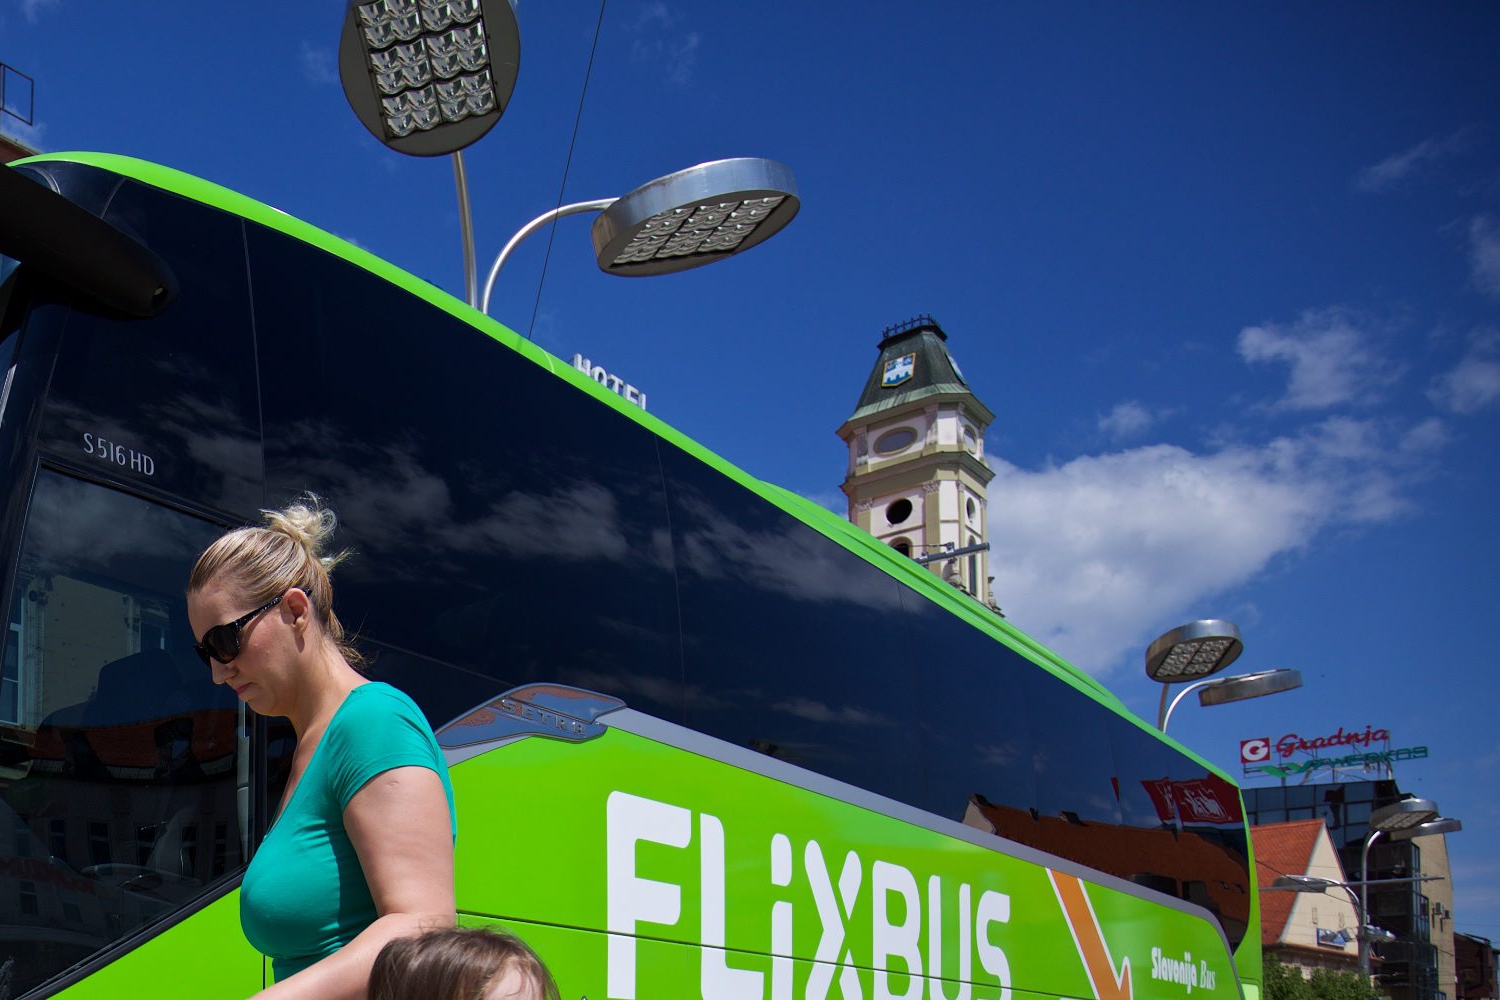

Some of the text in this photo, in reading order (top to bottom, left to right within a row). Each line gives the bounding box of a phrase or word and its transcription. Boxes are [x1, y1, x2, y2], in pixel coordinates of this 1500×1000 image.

[83, 432, 155, 476] S 516 HD
[501, 698, 586, 733] SETRA
[1276, 725, 1389, 758] Gradnja
[1151, 946, 1216, 995] Slavonija Bus
